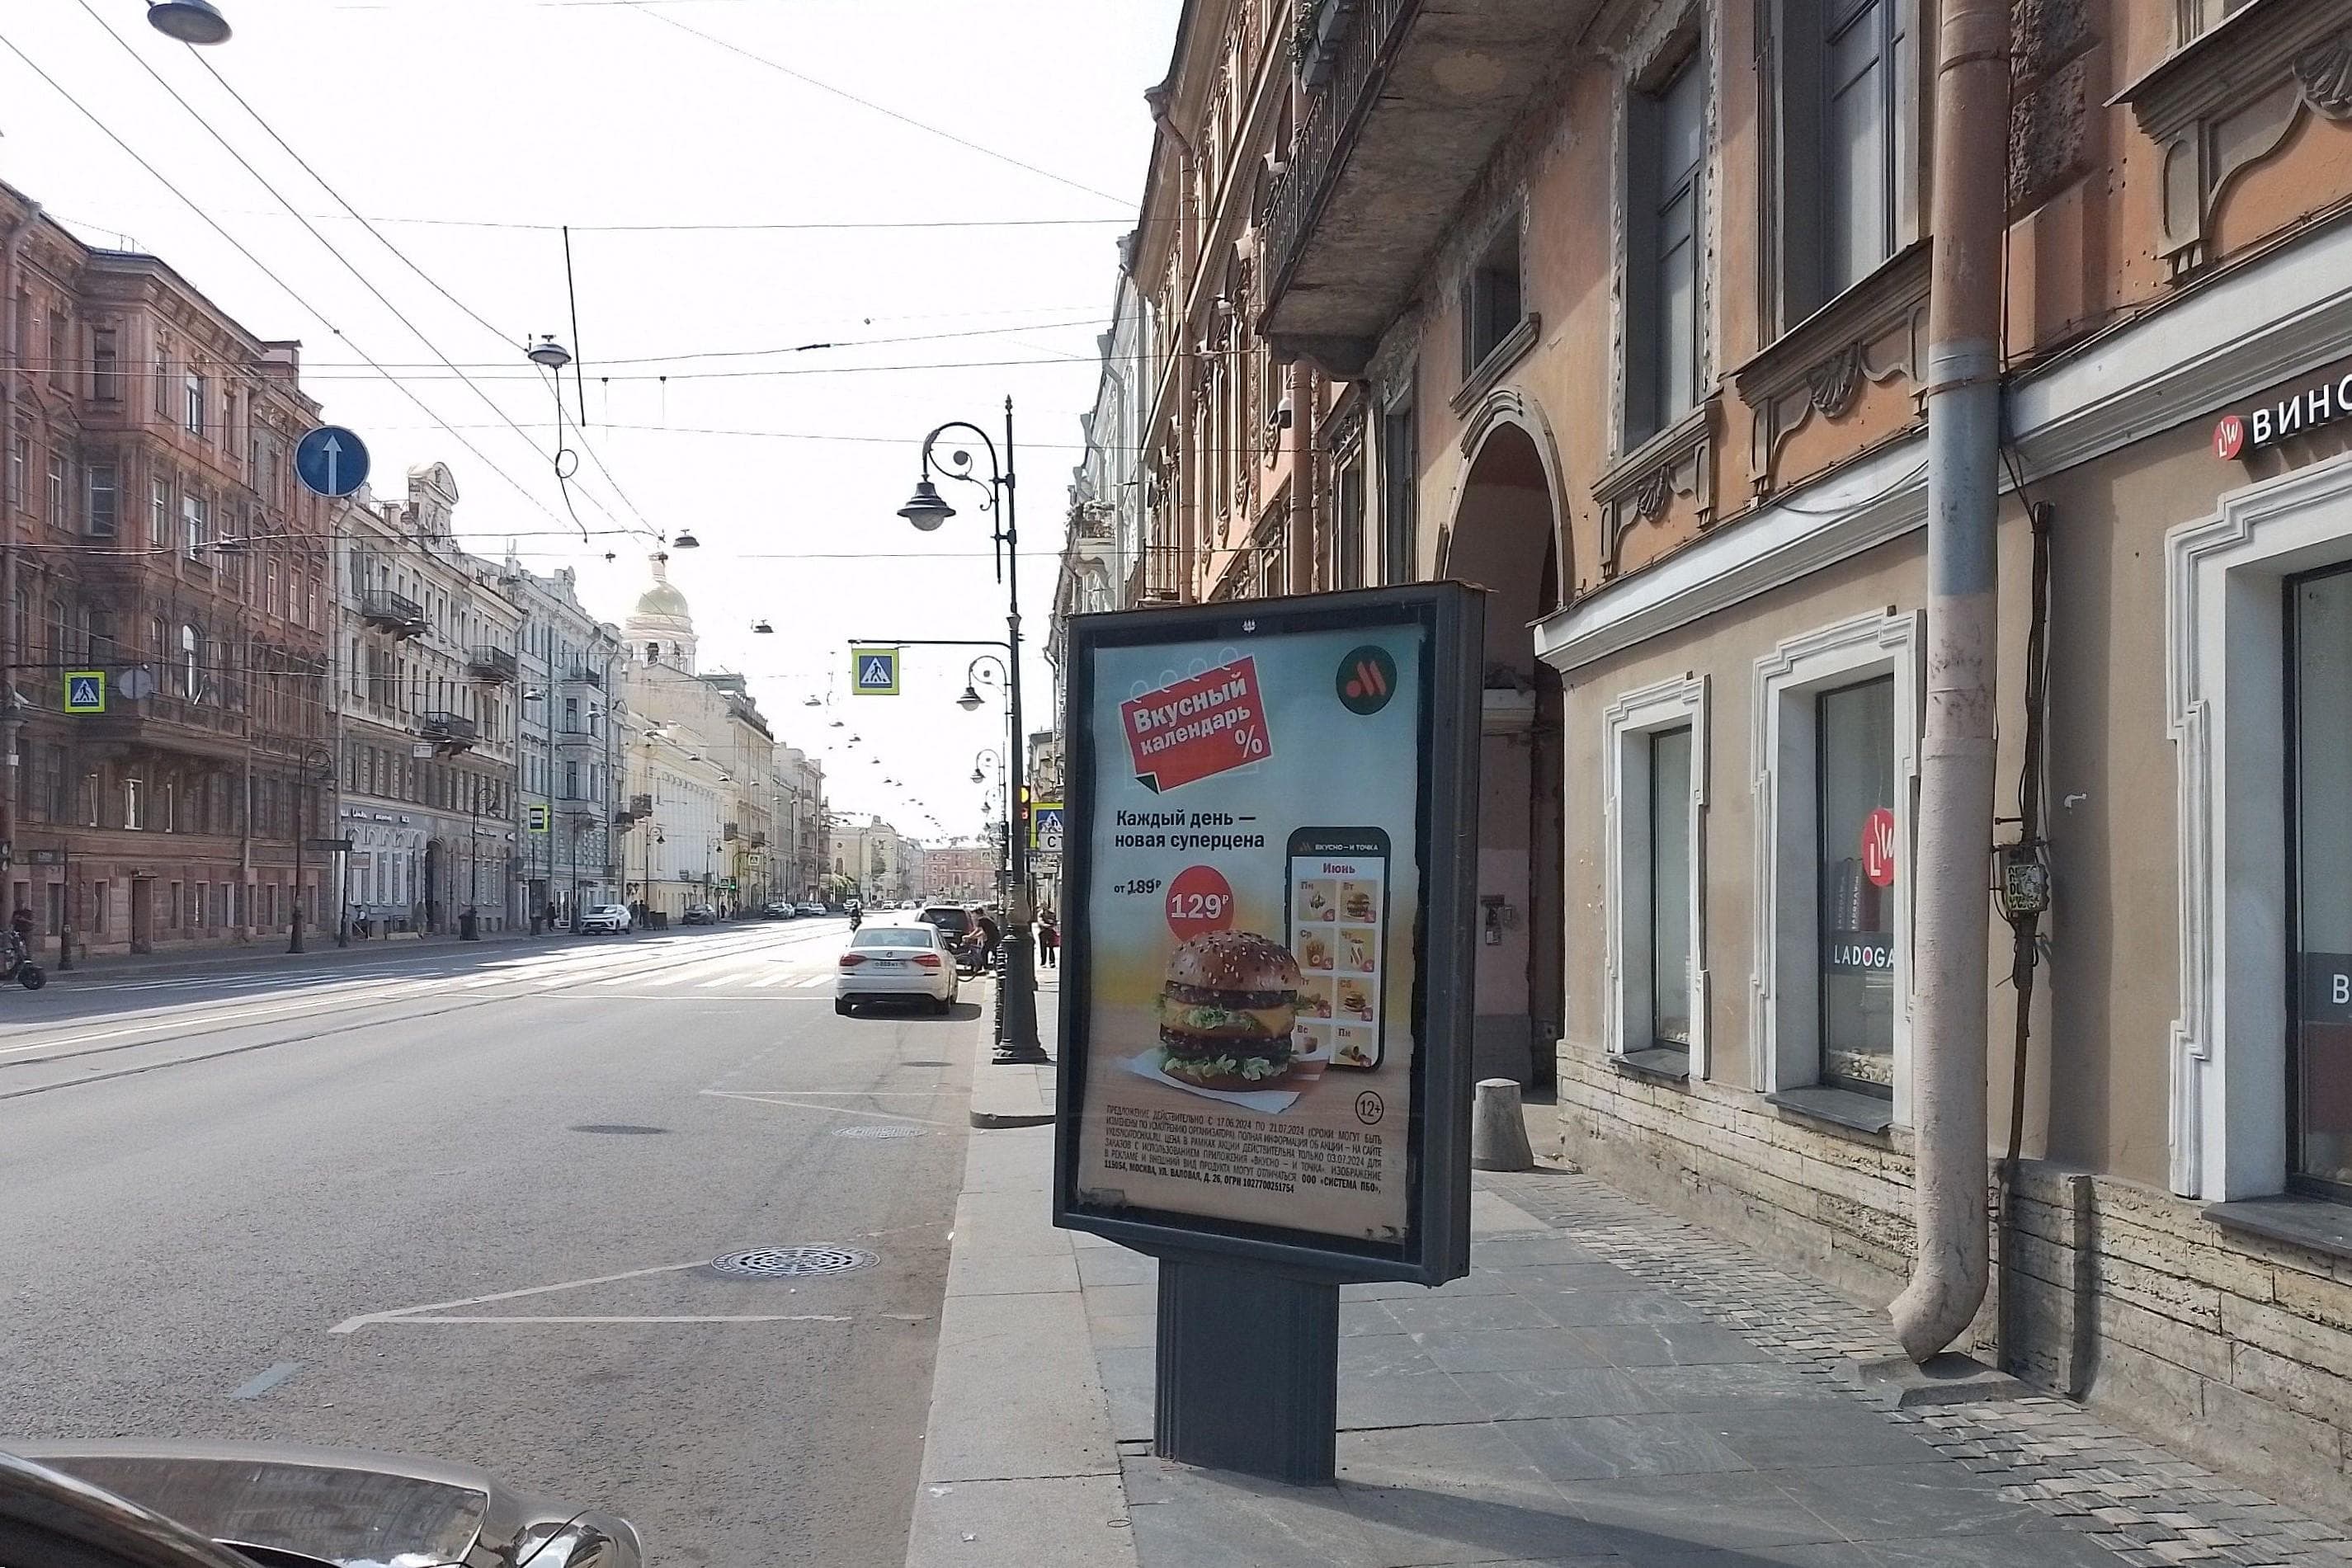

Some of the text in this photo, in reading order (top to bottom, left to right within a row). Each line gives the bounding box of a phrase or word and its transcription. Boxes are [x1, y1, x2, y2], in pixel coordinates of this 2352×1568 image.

[1134, 671, 1247, 733] Вкусный
[1140, 706, 1251, 756] календарь
[1235, 725, 1263, 758] %
[1116, 809, 1185, 828] Каждый
[1190, 812, 1233, 828] день
[1115, 834, 1265, 850] новая суперцена
[1322, 862, 1355, 873] Июнь
[1114, 885, 1124, 893] от
[1834, 944, 1894, 968] LADOGA
[1360, 1100, 1381, 1117] 12+
[1238, 1131, 1262, 1142] ПОЛНАЯ
[1264, 1134, 1308, 1148] ИНФОРМАЦИЯ
[1310, 1139, 1319, 1149] ОБ
[1321, 1140, 1343, 1152] АКЦИИ
[1353, 1144, 1361, 1154] НА
[1363, 1145, 1383, 1156] САЙТЕ
[1256, 1121, 1266, 1131] ПО
[1339, 1131, 1360, 1142] МОГУТ
[1365, 1133, 1382, 1145] БЫТЬ
[1165, 1134, 1181, 1145] ЦЕНА
[1190, 1137, 1215, 1148] РАМКАХ
[1242, 1142, 1295, 1158] ДЕЙСТВИТЕЛЬНА
[1299, 1149, 1324, 1161] ТОЛЬКО
[1367, 1158, 1382, 1169] ДЛЯ
[1104, 1159, 1128, 1172] 115054,
[1129, 1162, 1157, 1175] МОСКВА,
[1158, 1166, 1169, 1176] УЛ.
[1171, 1168, 1202, 1182] ВАЛОВАЯ,
[1212, 1174, 1223, 1185] 26,
[1224, 1175, 1242, 1186] ОГРН
[1243, 1178, 1294, 1194] 1027700251754
[1183, 1157, 1197, 1170] ВИД
[1200, 1160, 1230, 1173] ПРОДУКТА
[1233, 1165, 1254, 1176] МОГУТ
[1331, 1165, 1382, 1181] ИЗОБРАЖЕНИЕ
